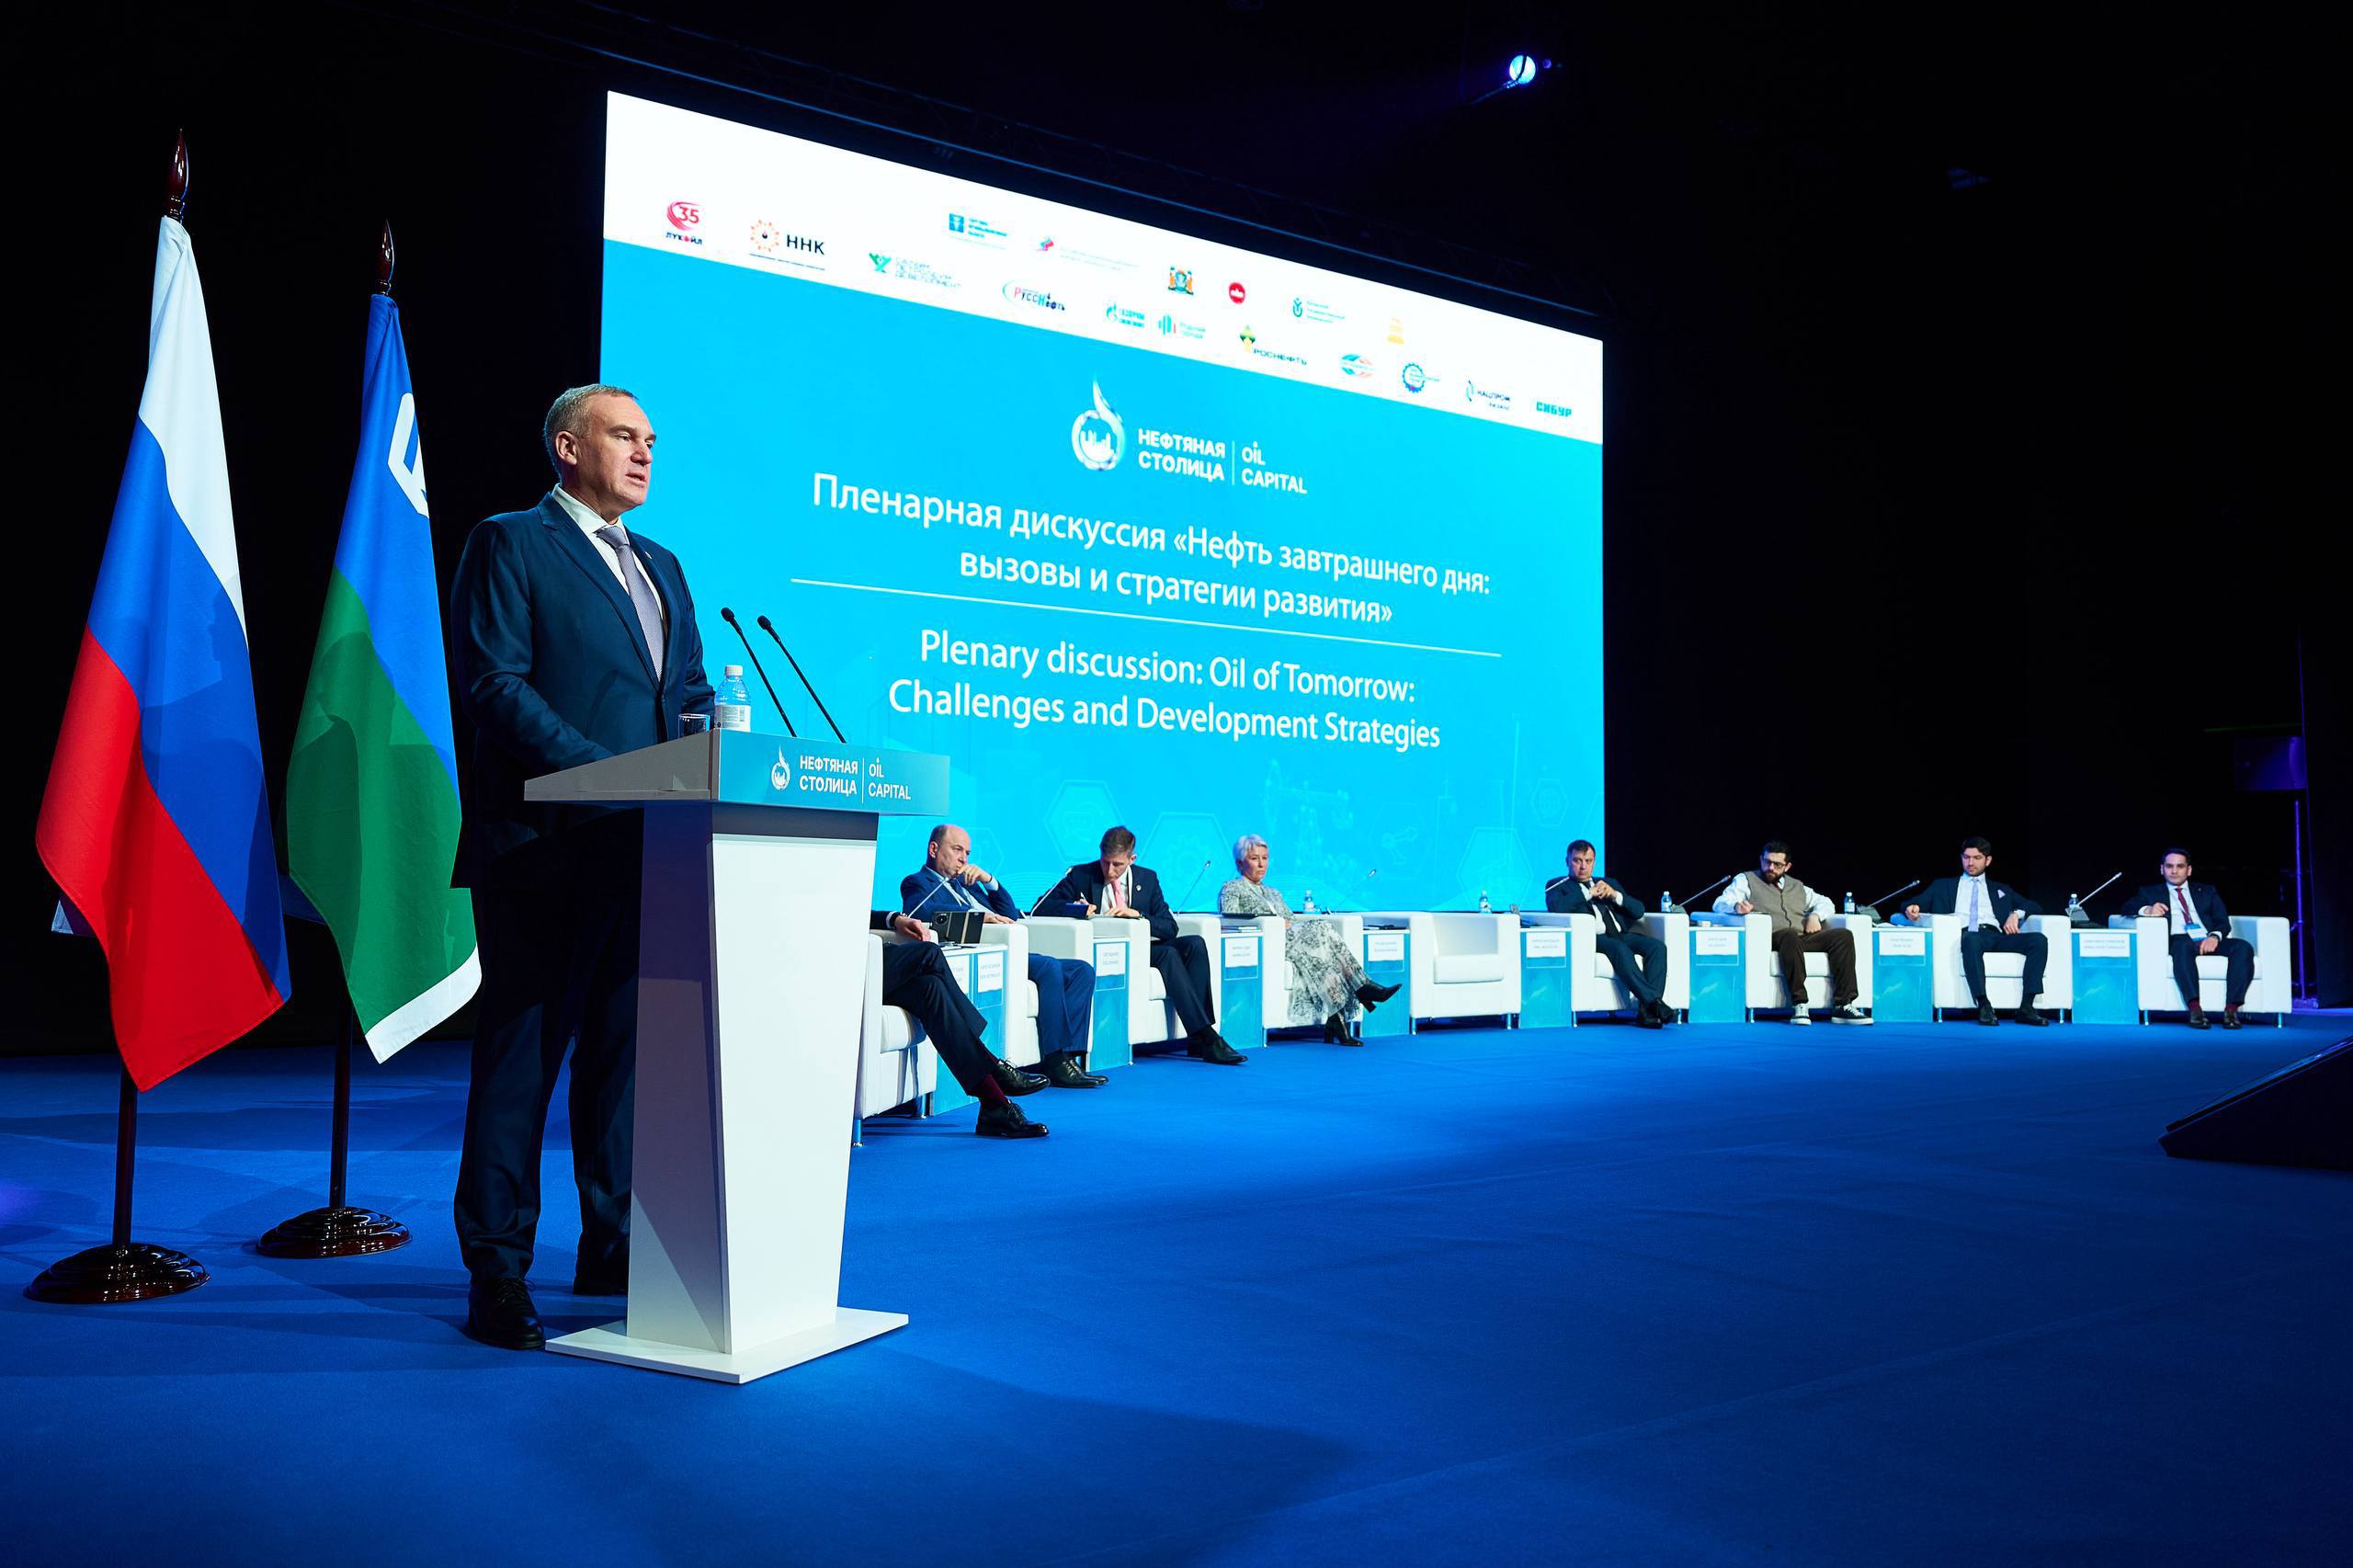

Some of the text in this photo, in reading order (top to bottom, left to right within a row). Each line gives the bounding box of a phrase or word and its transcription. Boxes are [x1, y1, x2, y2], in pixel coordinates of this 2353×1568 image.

[679, 205, 699, 224] 35
[786, 233, 824, 256] ННК
[1536, 401, 1573, 417] СИБУР
[1138, 428, 1226, 459] НЕФТЯНАЯ
[1138, 450, 1225, 483] СТОЛИЦА
[1242, 468, 1308, 494] CAPITAL
[813, 472, 1491, 596] Пленарная дискуссия «Нефть завтрашнего дня:
[960, 551, 1393, 624] вызовы и стратегии развития»
[920, 628, 1415, 703] Plenary discussion: Oil of Tomorrow:
[888, 677, 1441, 753] Challenges and Development Strategies
[800, 756, 858, 775] НЕФТЯНАЯ
[799, 776, 858, 797] СТОЛИЦА
[869, 782, 912, 801] CAPITAL
